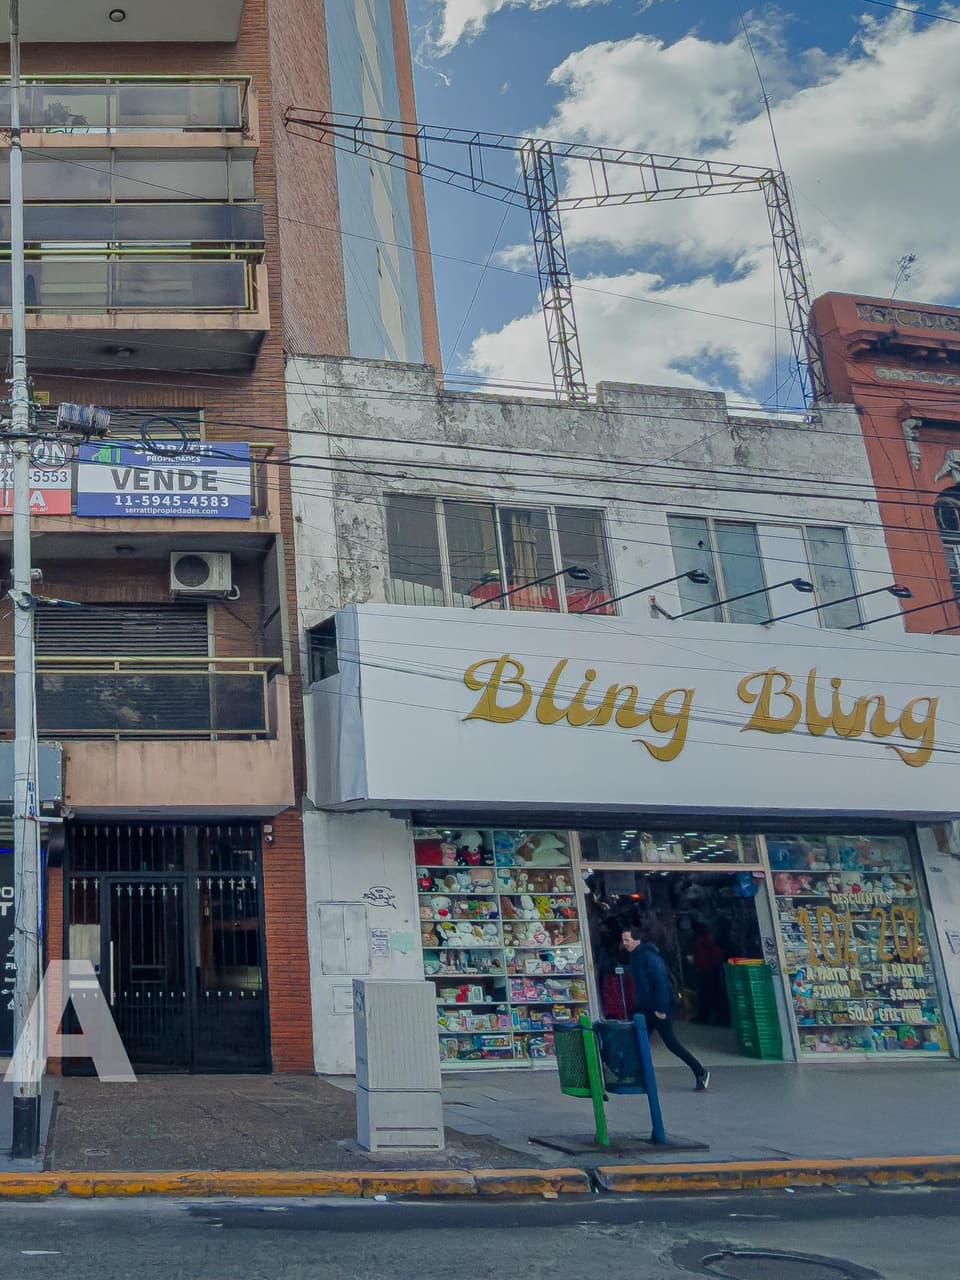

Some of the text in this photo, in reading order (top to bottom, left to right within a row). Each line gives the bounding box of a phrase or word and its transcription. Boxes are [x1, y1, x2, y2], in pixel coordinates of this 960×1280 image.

[110, 468, 218, 492] VENDE
[114, 495, 230, 508] 11-5945-4583
[125, 507, 219, 516] serrattipropiedades.com
[462, 653, 939, 768] Bling Bling
[831, 892, 893, 905] DESCUENTOS
